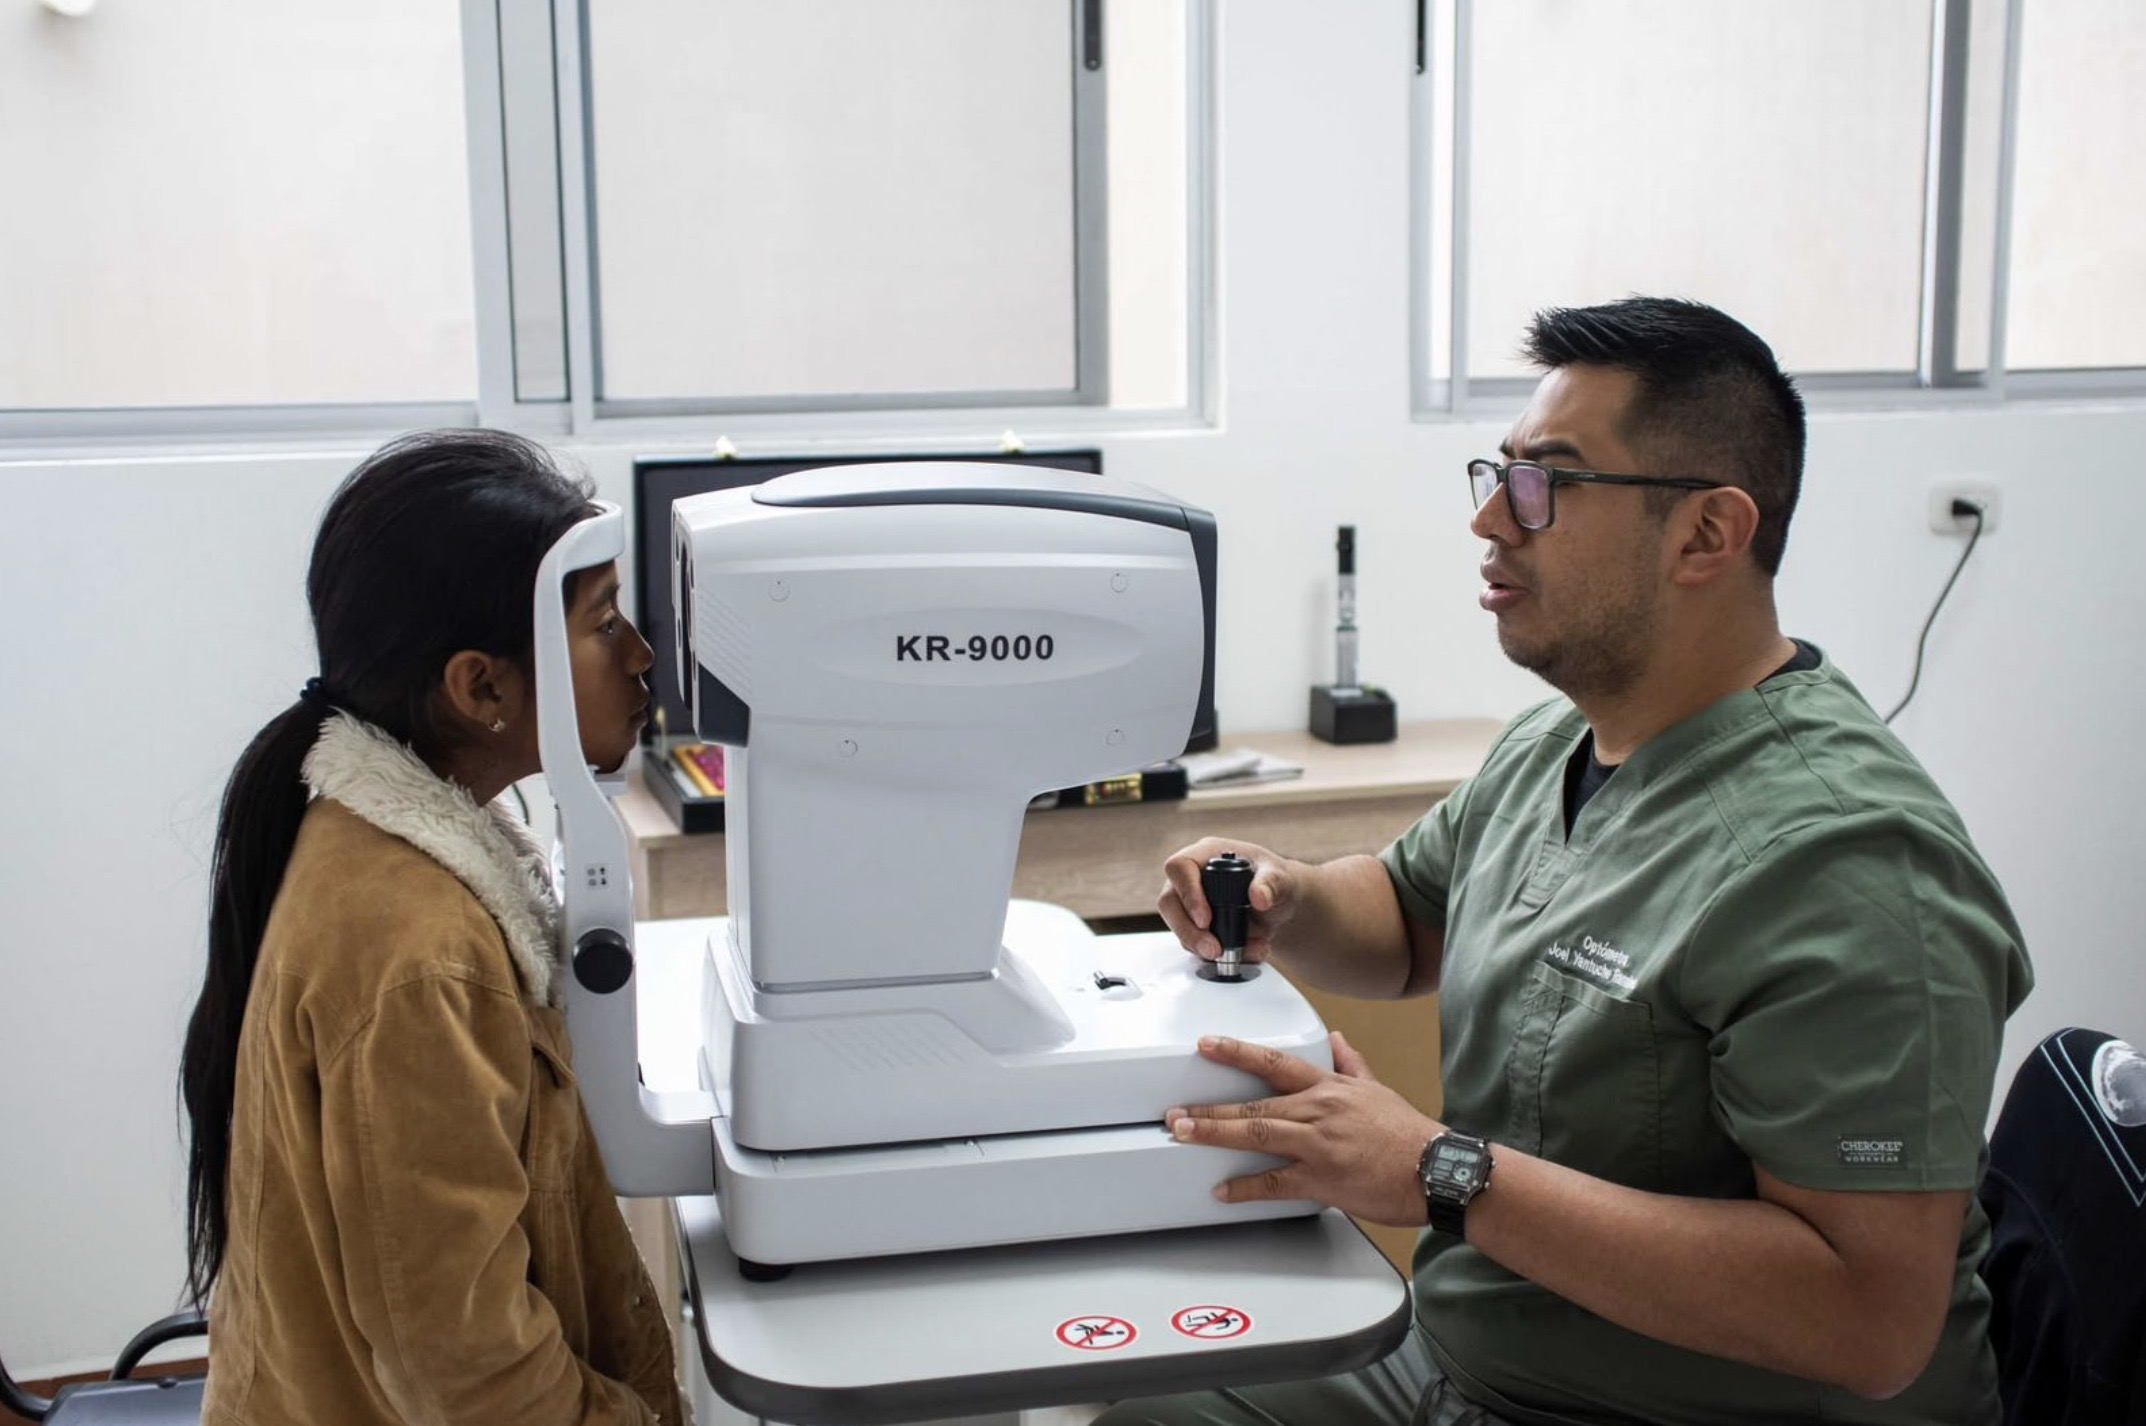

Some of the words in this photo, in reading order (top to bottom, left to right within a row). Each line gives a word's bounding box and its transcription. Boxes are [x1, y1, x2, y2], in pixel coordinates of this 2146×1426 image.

[896, 634, 1054, 662] KR-9000
[1548, 941, 1570, 962] Joel
[1840, 1140, 1901, 1152] CHEROKEE
